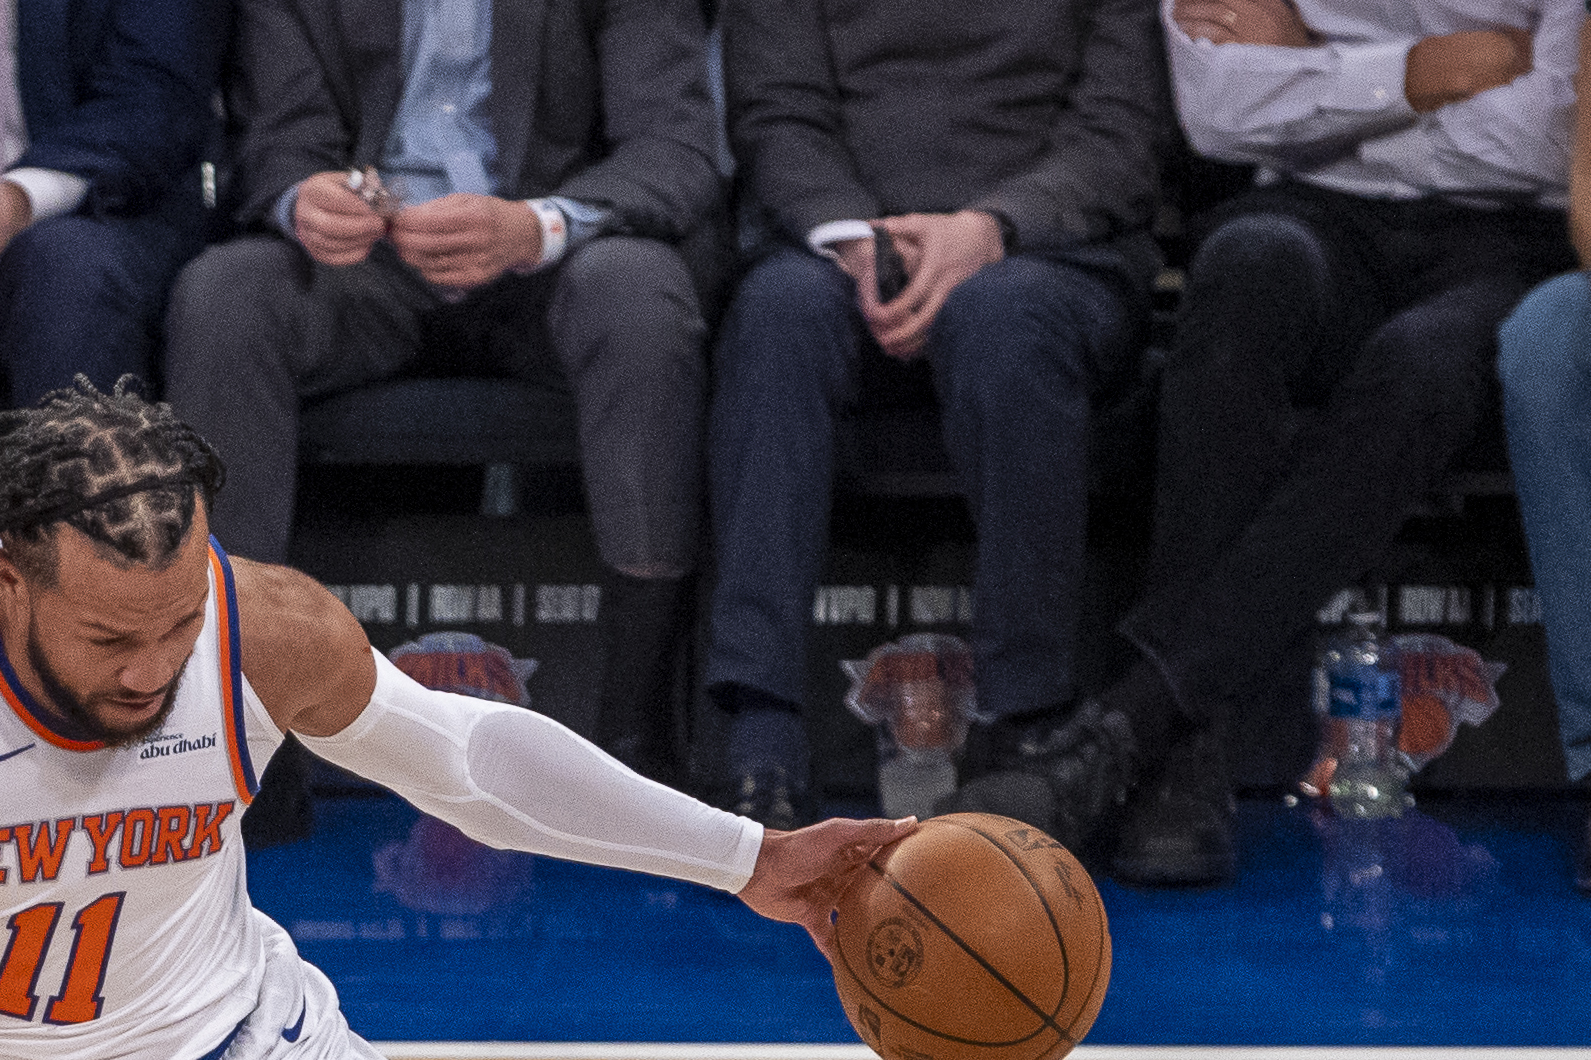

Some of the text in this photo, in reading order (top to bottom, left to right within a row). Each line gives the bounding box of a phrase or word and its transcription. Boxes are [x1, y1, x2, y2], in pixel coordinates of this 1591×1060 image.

[140, 732, 217, 760] abu dhabi
[81, 800, 235, 876] YORK
